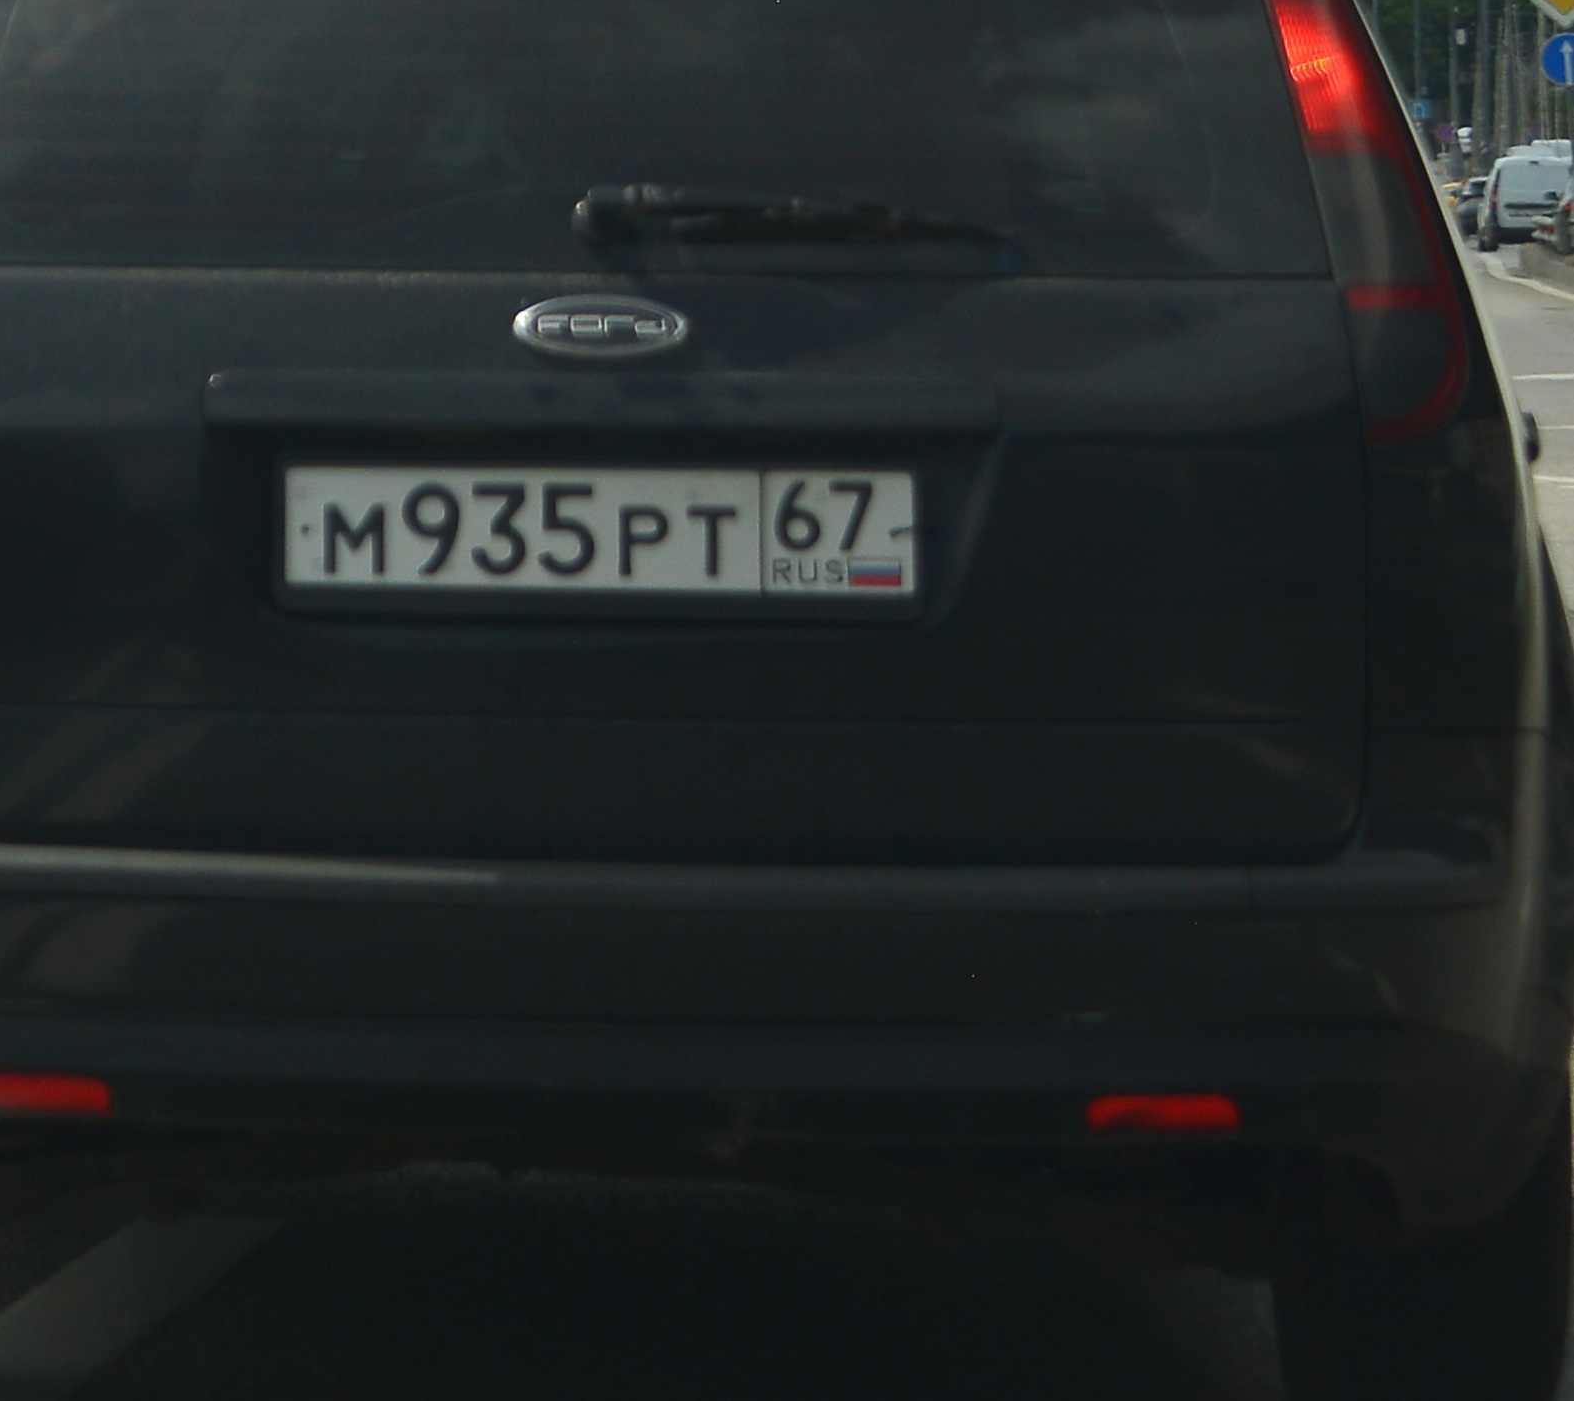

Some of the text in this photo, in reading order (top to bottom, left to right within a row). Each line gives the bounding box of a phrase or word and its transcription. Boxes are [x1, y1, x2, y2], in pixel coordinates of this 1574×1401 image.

[321, 479, 873, 579] М935РТ 67
[772, 557, 844, 585] RUS
